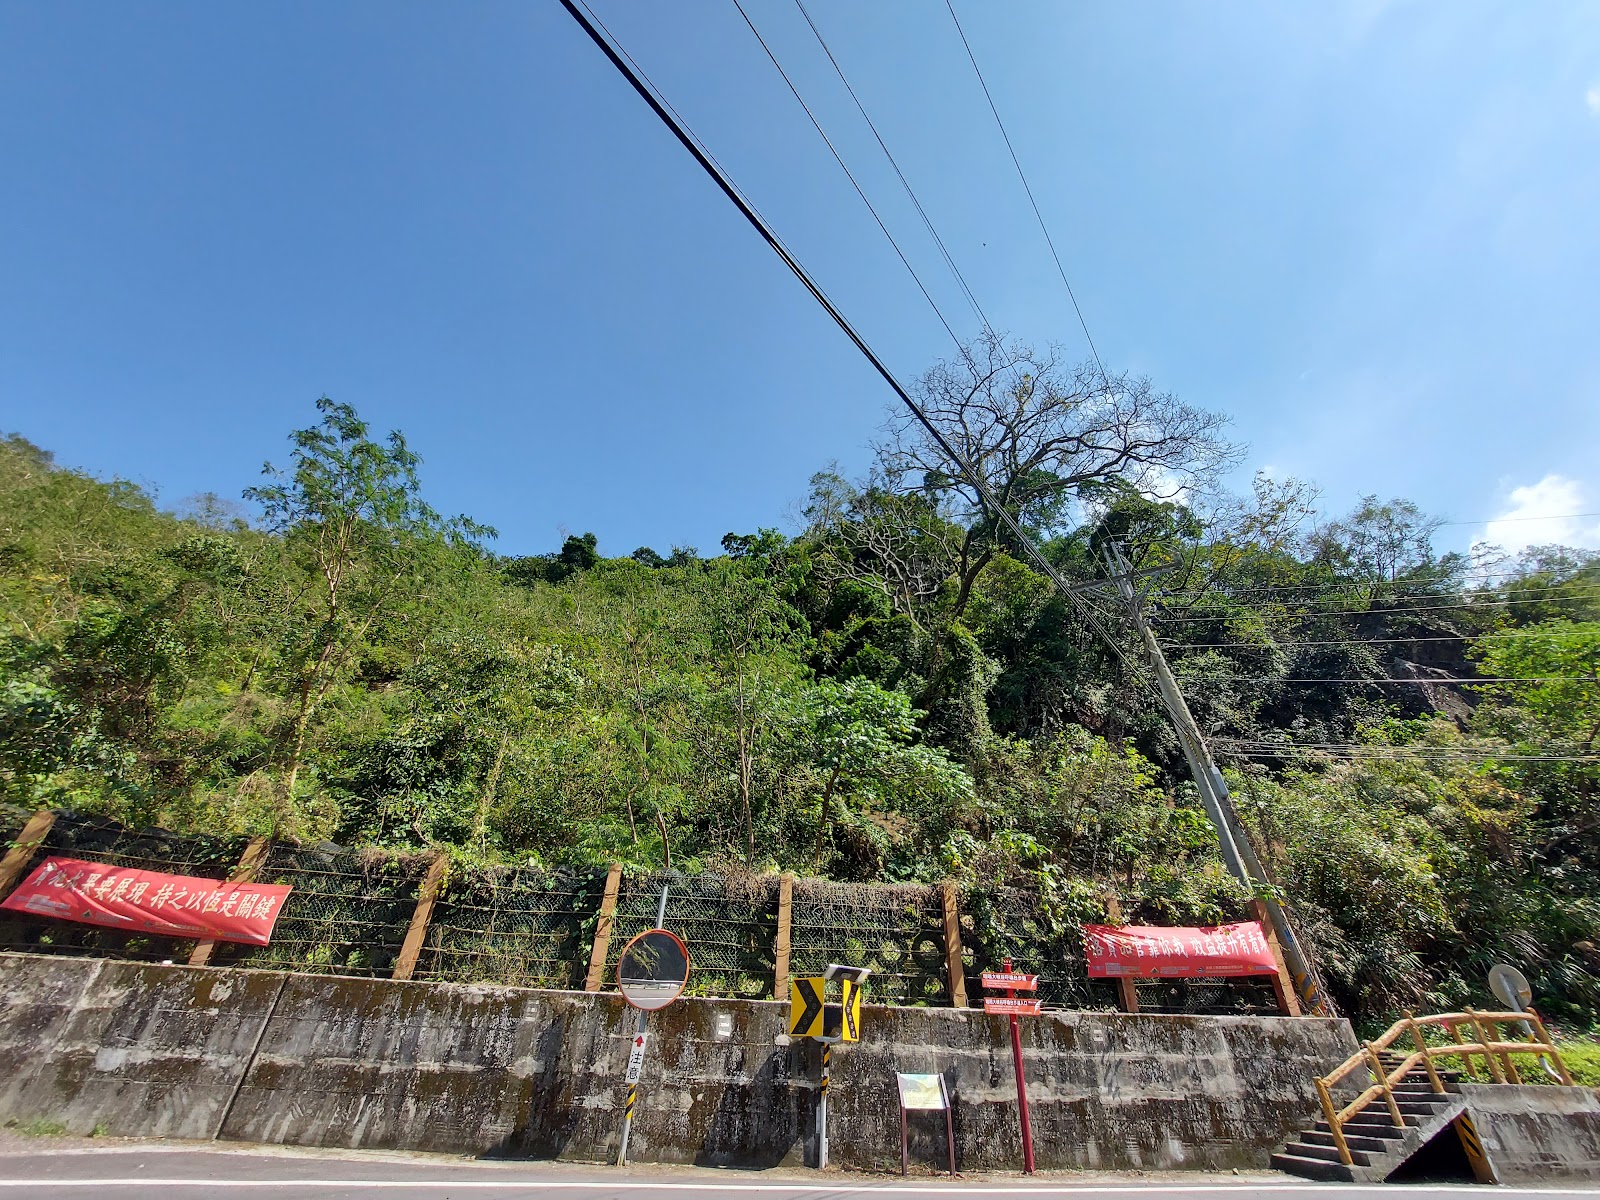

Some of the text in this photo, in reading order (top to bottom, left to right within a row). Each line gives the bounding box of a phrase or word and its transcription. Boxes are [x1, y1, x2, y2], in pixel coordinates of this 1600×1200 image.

[150, 883, 276, 920] 持之以恆是關鍵
[1189, 930, 1269, 956] 效益提升有看頭
[627, 1051, 642, 1079] 注意
